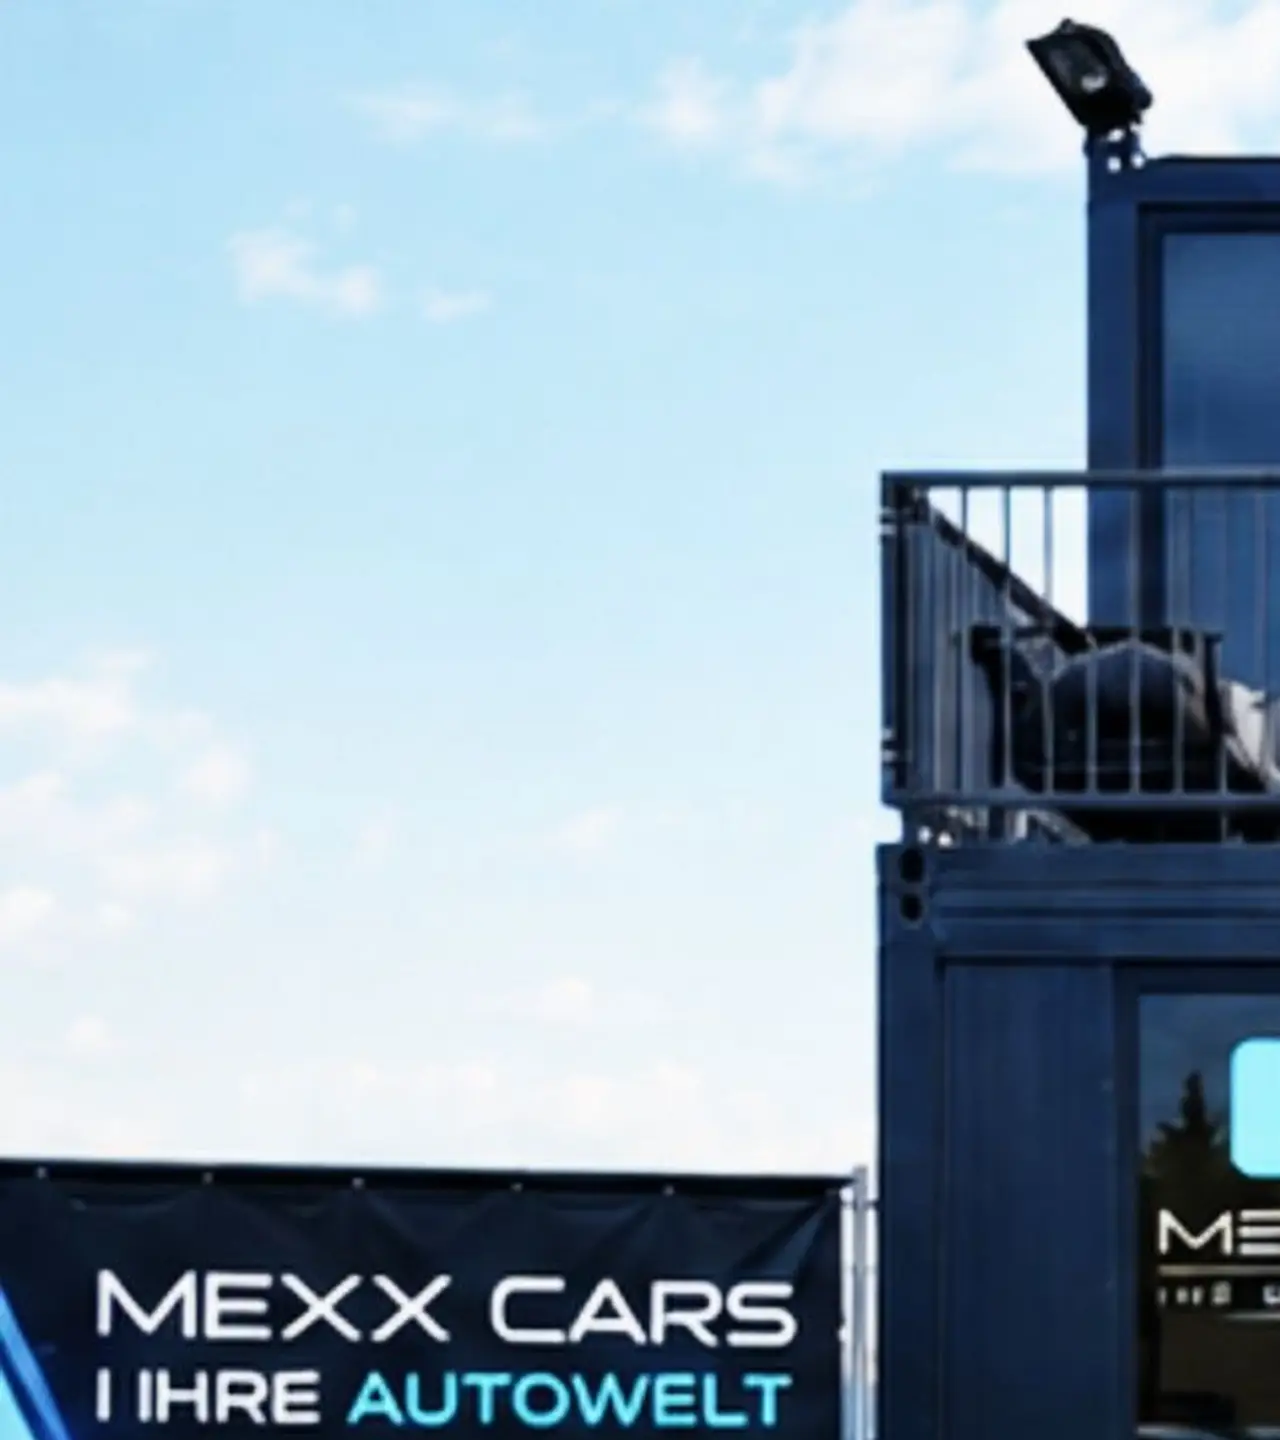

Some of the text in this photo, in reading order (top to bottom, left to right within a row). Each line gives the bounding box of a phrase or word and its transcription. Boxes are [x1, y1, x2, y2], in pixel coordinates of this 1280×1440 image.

[96, 1268, 798, 1348] MEXX CARS
[137, 1368, 321, 1425] IHRE
[347, 1372, 793, 1428] AUTOWELT
